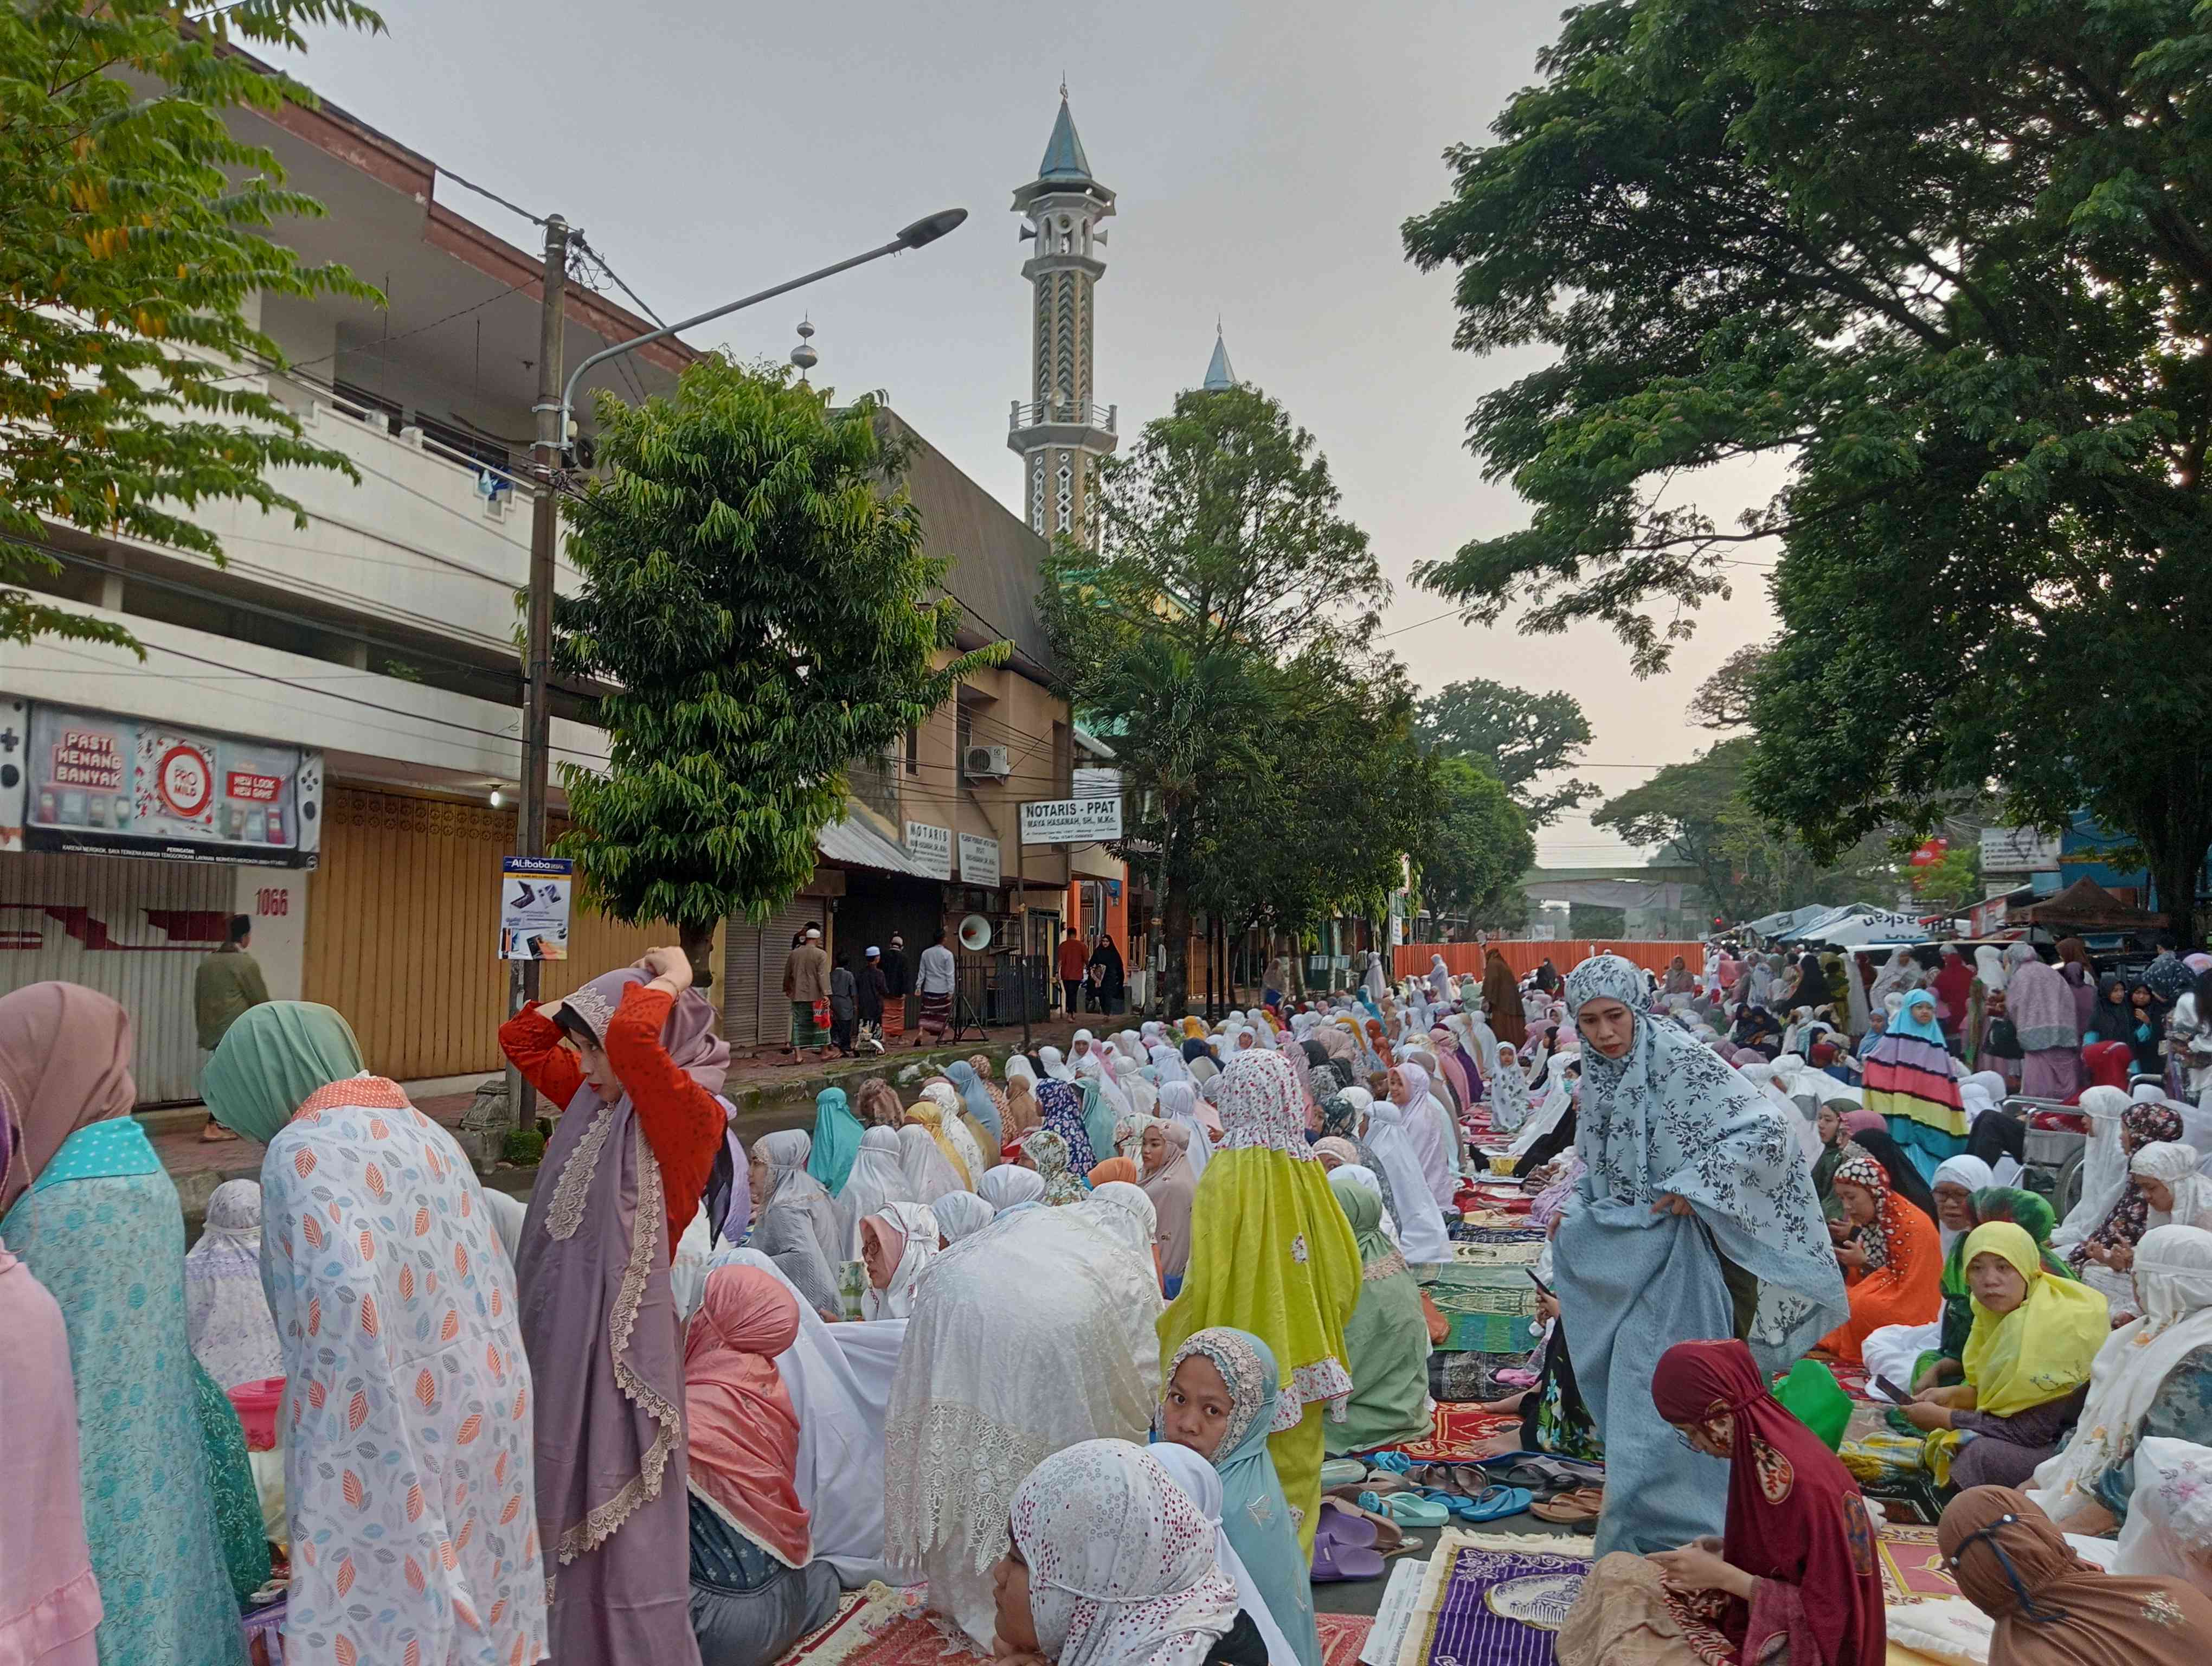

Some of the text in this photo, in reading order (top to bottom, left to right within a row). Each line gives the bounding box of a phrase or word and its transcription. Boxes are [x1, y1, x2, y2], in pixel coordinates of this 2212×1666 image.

[66, 733, 113, 752] PASTI
[56, 748, 121, 770] MENANG
[56, 766, 121, 787] BANYAK
[253, 778, 275, 789] LOOK
[1026, 803, 1076, 818] NOTARIS
[1086, 801, 1115, 814] PPAT
[910, 824, 947, 842] NOTARIS
[255, 888, 287, 915] 1066
